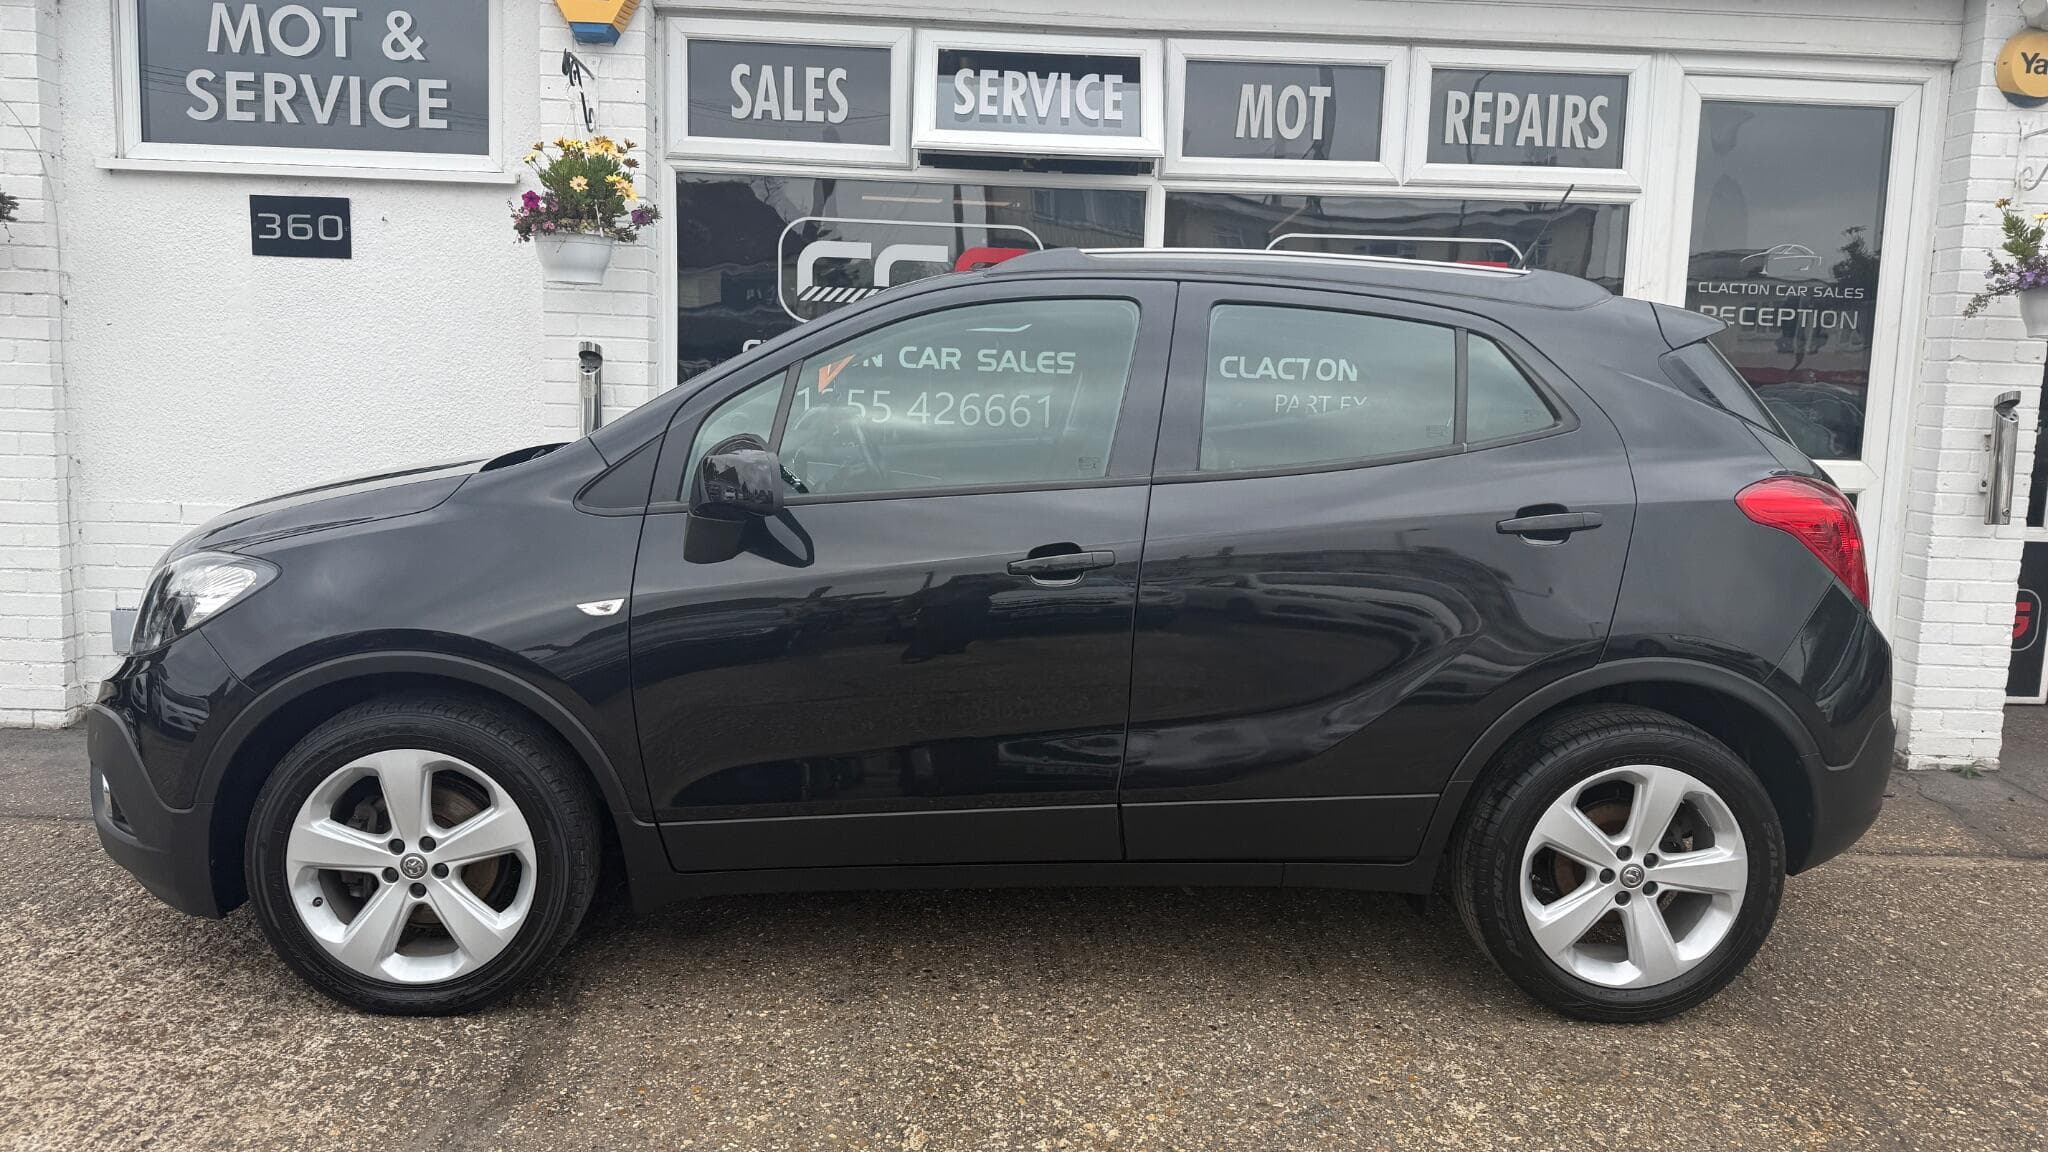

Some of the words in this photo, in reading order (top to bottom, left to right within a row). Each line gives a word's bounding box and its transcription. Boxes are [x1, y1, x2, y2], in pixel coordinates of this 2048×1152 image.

[207, 2, 358, 58] MOT
[381, 10, 426, 61] &
[185, 68, 449, 129] SERVICE
[730, 63, 849, 124] SALES
[953, 68, 1124, 120] SERVICE
[1235, 84, 1332, 140] MOT
[1444, 90, 1610, 150] REPAIRS
[257, 213, 344, 241] 360
[1698, 281, 1770, 296] CLACTON
[1775, 284, 1808, 298] CAR
[1813, 286, 1865, 299] SALES
[1700, 304, 1859, 330] RECEPTION
[899, 346, 962, 371] CAR
[977, 349, 1076, 374] SALES
[1219, 355, 1358, 382] CLACTON
[907, 391, 1051, 428] 426661
